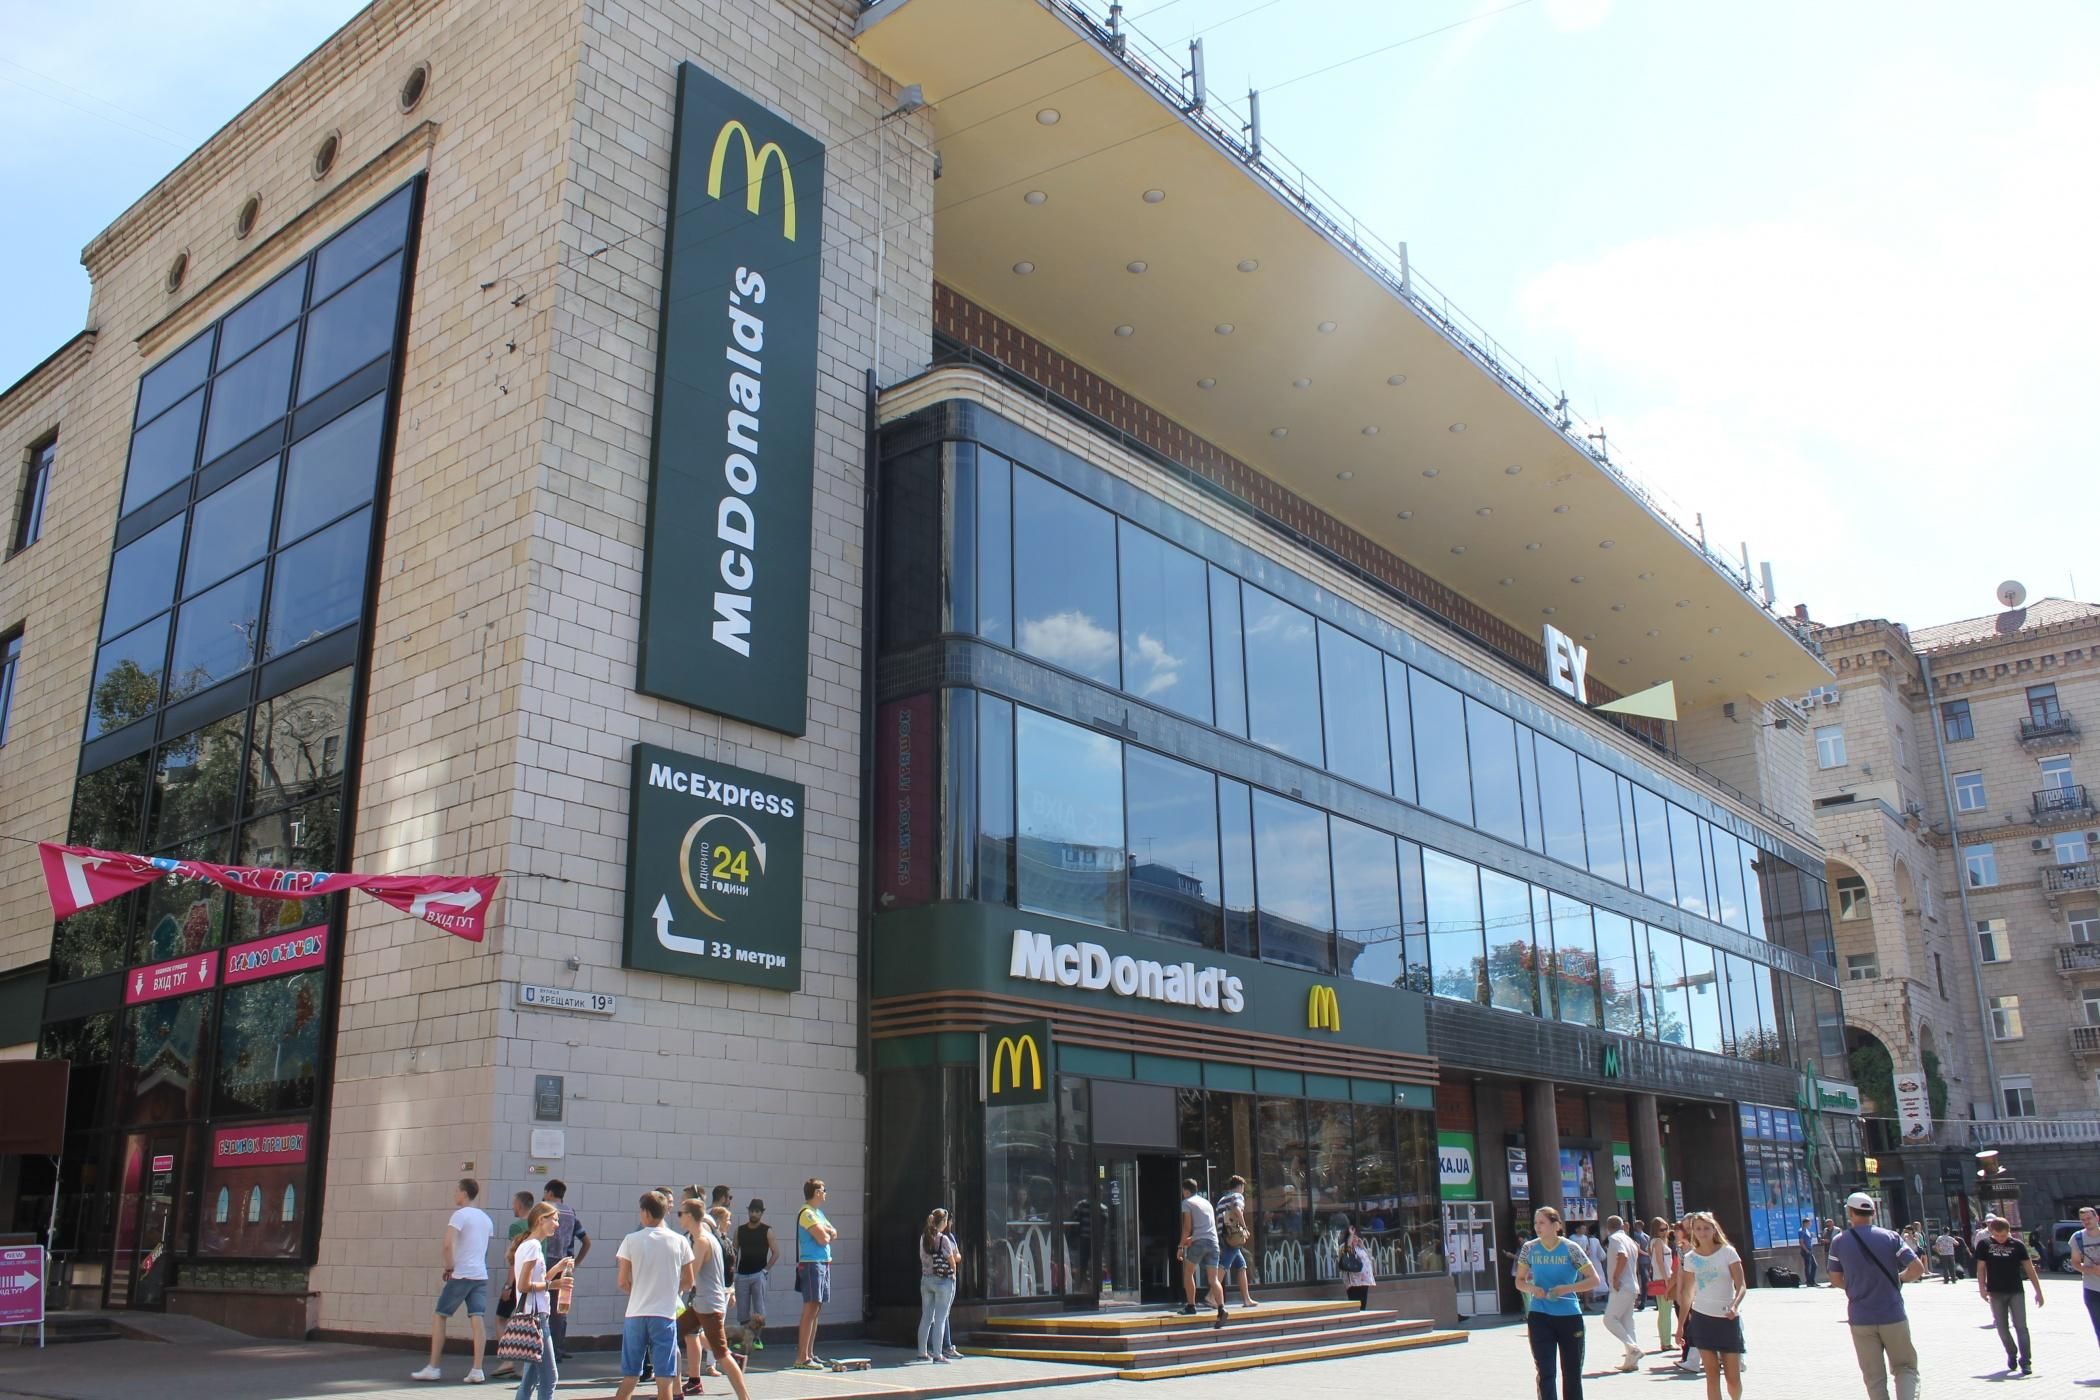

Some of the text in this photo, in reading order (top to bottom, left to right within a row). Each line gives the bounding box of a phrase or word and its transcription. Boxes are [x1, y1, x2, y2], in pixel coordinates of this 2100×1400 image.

[711, 265, 767, 658] McDonald's
[1542, 623, 1588, 704] EY
[648, 762, 794, 818] McExpress
[712, 845, 750, 883] 24
[426, 911, 454, 926] ВХІД
[711, 942, 786, 970] 33 метри
[153, 972, 188, 991] ВХІД ТУТ
[1010, 929, 1245, 1014] McDonald's
[540, 995, 585, 1008] ХРЕЩАТИК
[218, 1137, 261, 1156] БУДИНОК
[1531, 1255, 1568, 1265] UKRAINE
